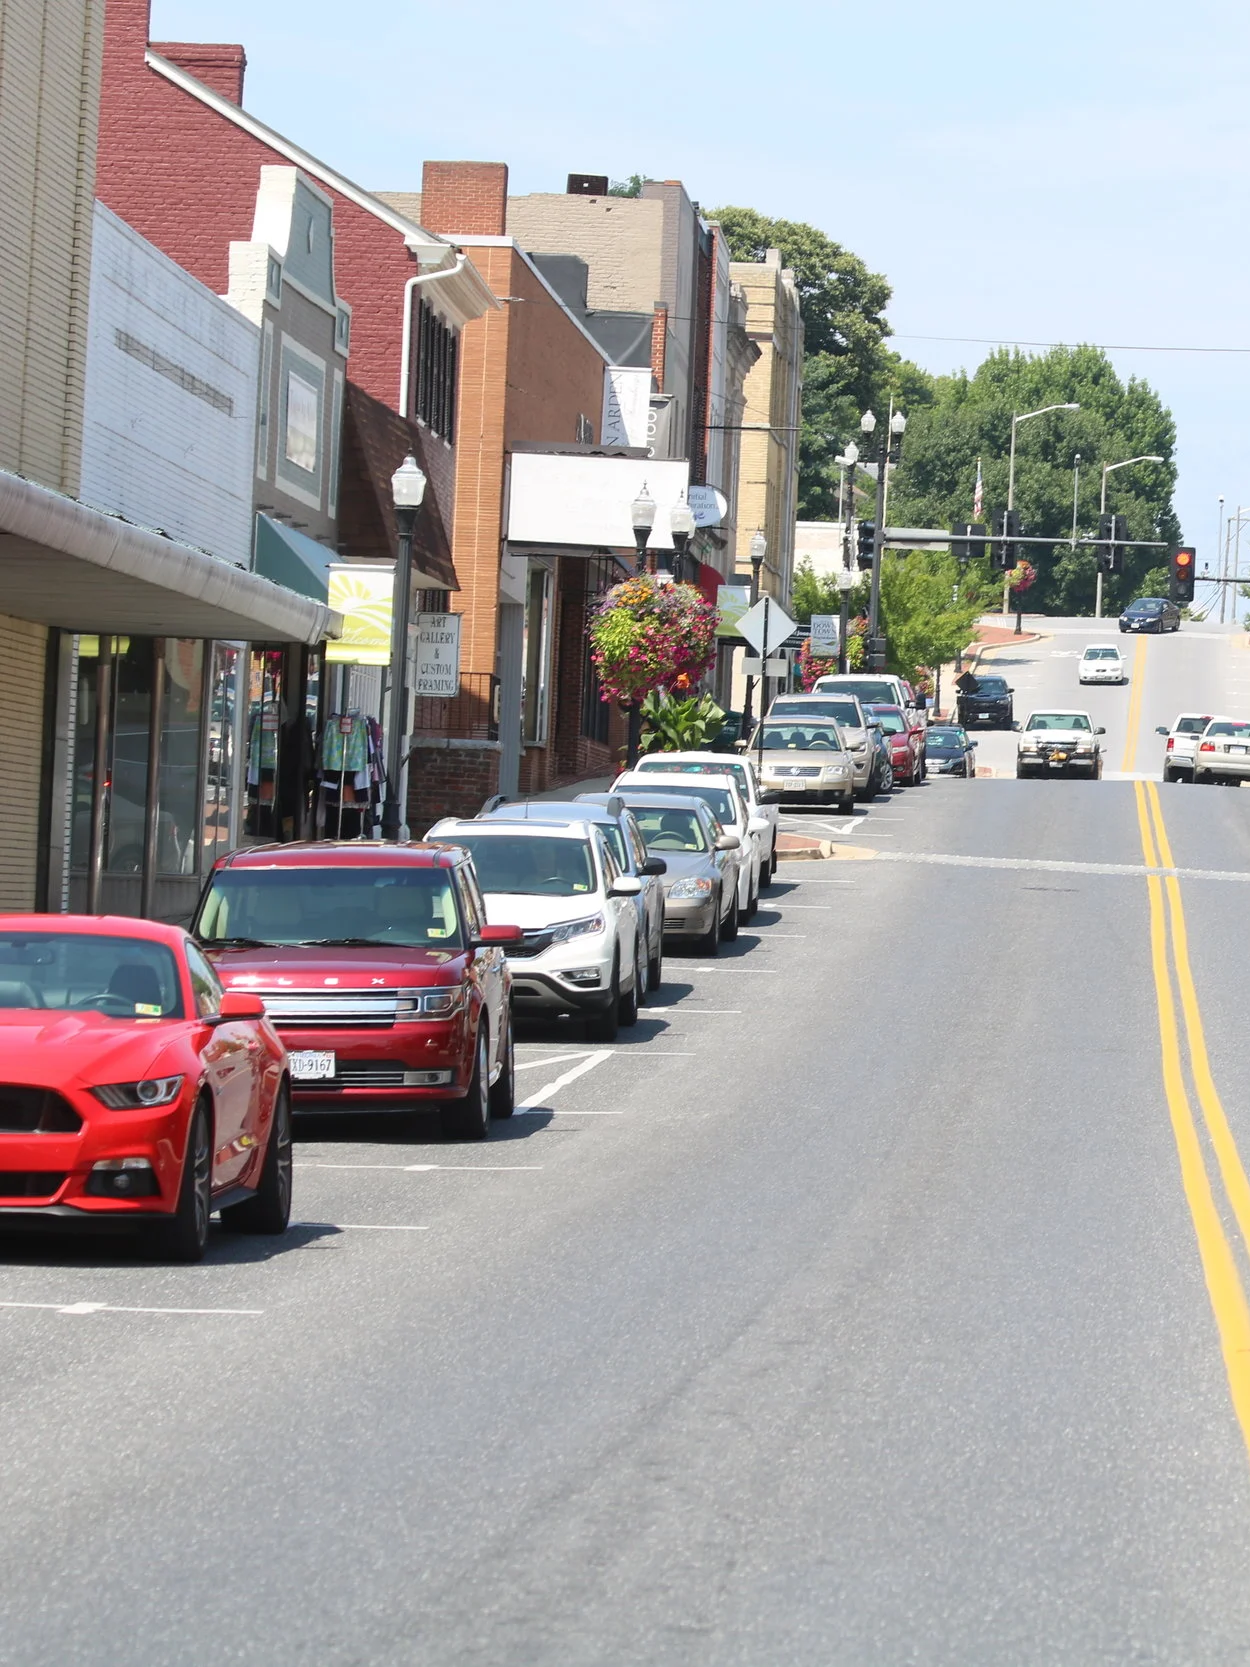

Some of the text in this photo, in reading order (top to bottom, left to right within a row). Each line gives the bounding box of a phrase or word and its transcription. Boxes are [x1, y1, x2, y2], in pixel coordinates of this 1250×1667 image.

[431, 616, 447, 628] ART
[421, 632, 455, 644] GALLERY
[434, 648, 440, 659] &
[421, 663, 452, 675] CUSTOM
[418, 679, 454, 691] FRAMING
[291, 1058, 332, 1072] XD-9167
